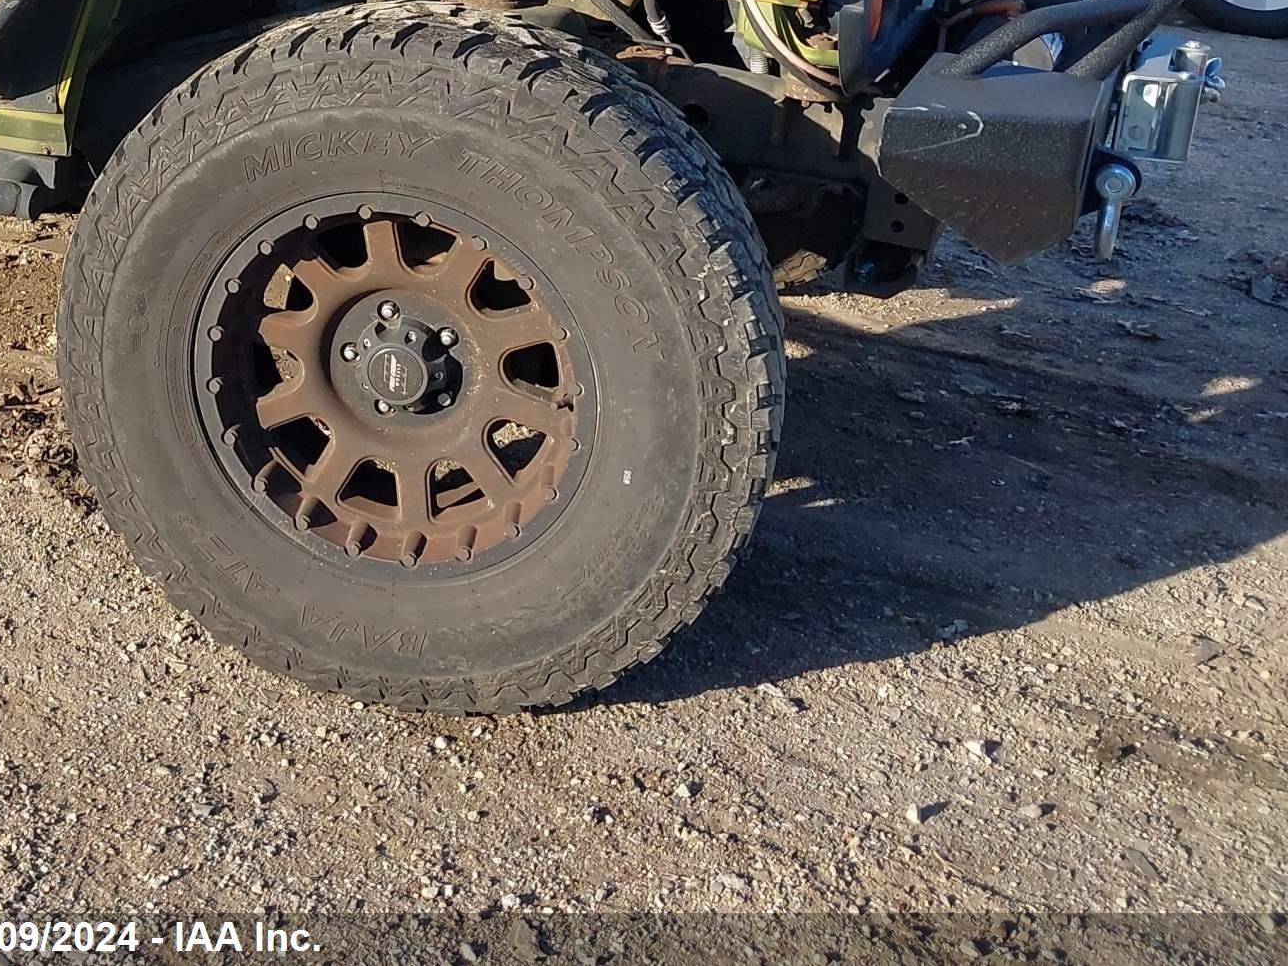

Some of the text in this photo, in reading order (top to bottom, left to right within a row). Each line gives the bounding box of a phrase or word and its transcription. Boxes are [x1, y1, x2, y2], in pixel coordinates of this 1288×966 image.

[242, 131, 666, 362] MICKEY THOMPSON
[298, 602, 429, 659] BAJA
